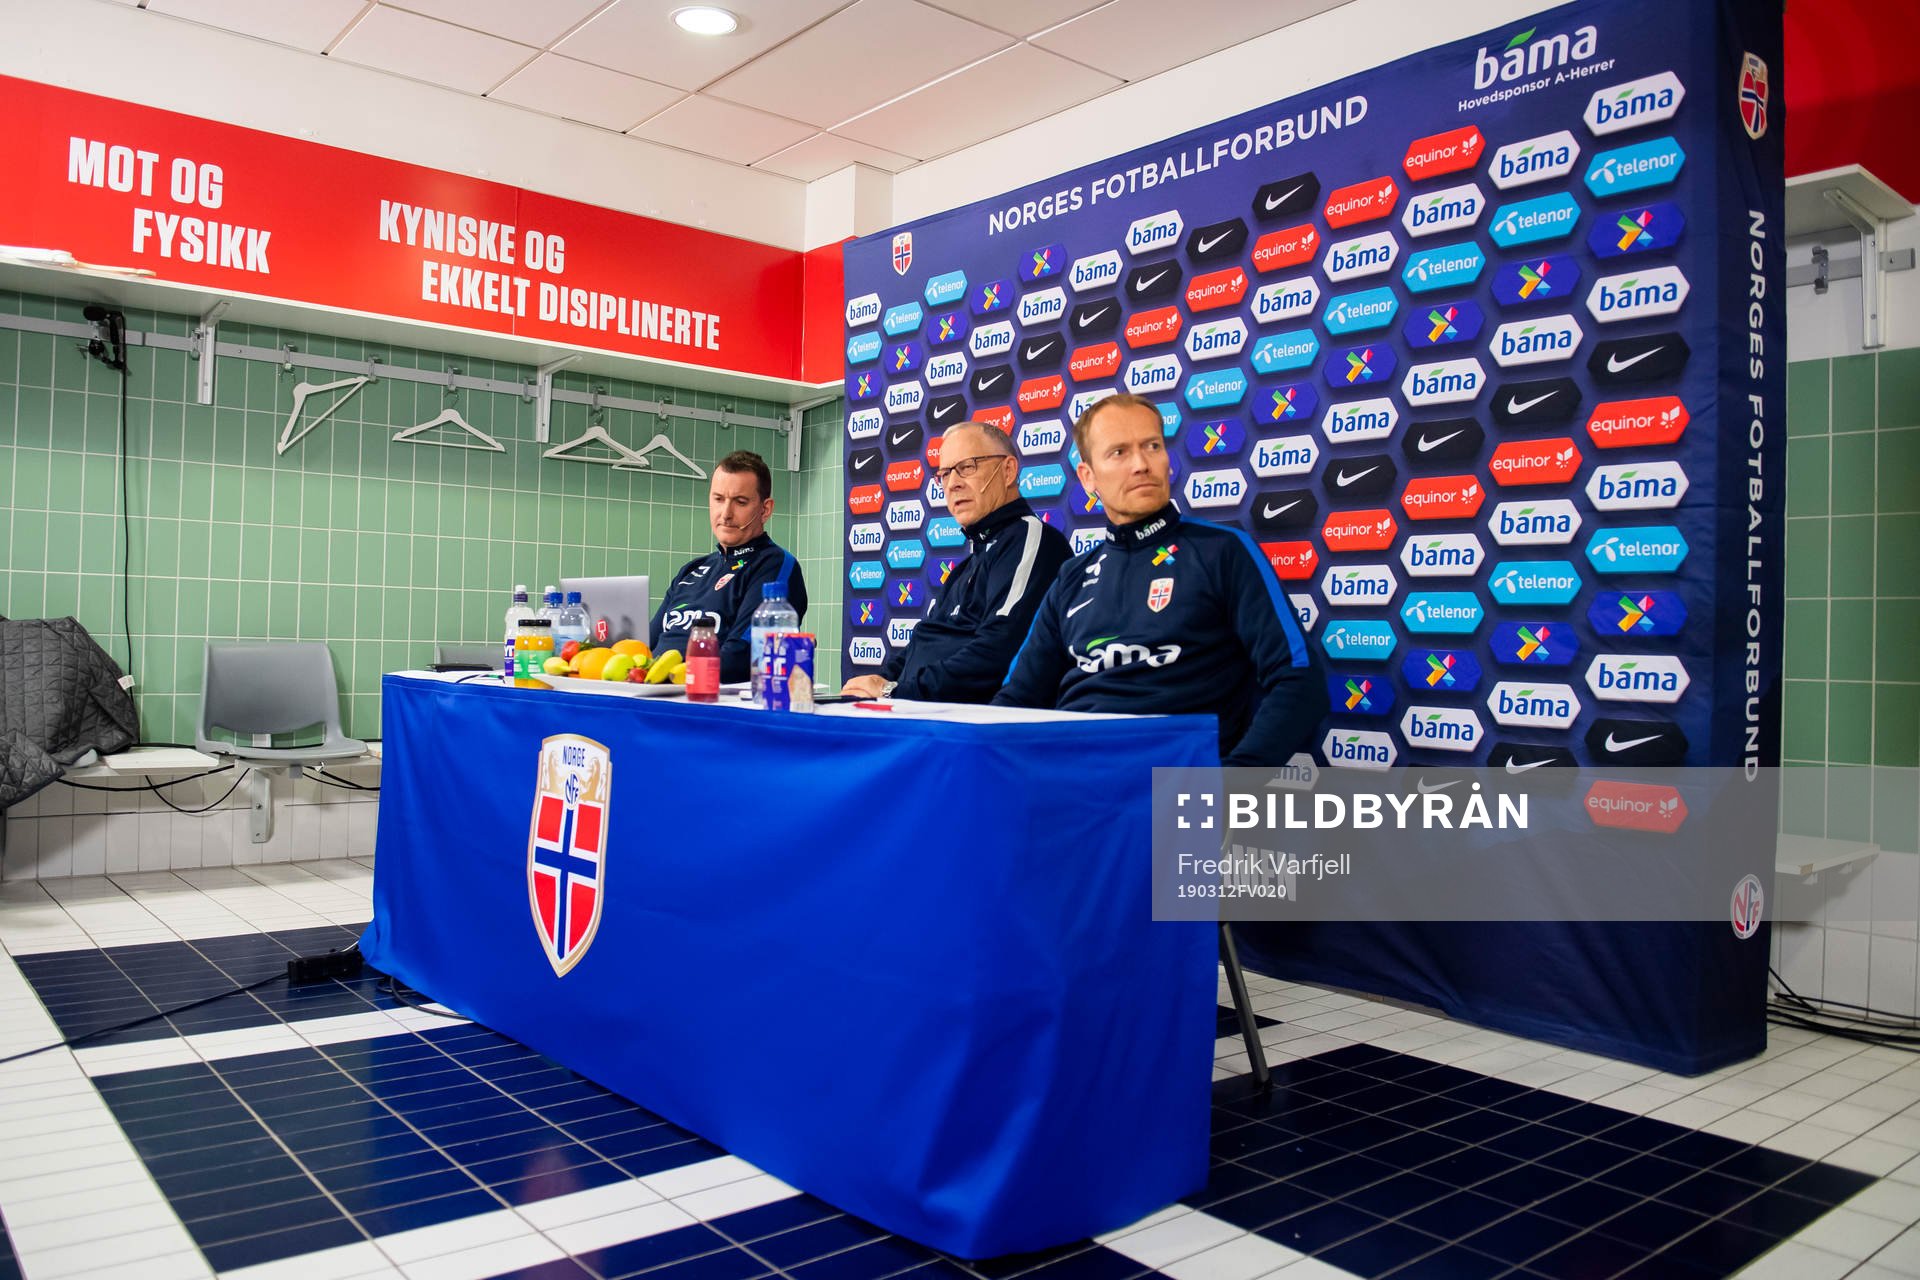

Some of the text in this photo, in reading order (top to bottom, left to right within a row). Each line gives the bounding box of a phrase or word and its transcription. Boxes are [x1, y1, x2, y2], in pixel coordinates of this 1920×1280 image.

[1473, 25, 1597, 90] bama
[1457, 57, 1616, 112] Hovedsponsor A-Herrer
[1596, 87, 1674, 125] bama
[988, 95, 1368, 235] NORGES FOTBALLFORBUND
[1406, 146, 1458, 168] equinor
[1499, 145, 1570, 179] bama
[1617, 151, 1678, 175] telenor
[68, 136, 223, 209] MOT OG
[1326, 193, 1375, 217] equinor
[1412, 197, 1476, 227] bama
[1517, 205, 1574, 228] telenor
[132, 207, 272, 274] FYSIKK
[379, 199, 565, 274] KYNISKE OG
[1132, 222, 1177, 246] bama
[1254, 241, 1298, 260] equinor
[1332, 243, 1390, 273] bama
[1076, 262, 1117, 284] bama
[1428, 256, 1479, 276] telenor
[938, 281, 964, 294] telenor
[1187, 282, 1228, 301] equinor
[1600, 282, 1678, 312] bama
[422, 260, 720, 351] EKKELT DISIPLINERTE
[850, 303, 878, 320] bama
[1023, 297, 1061, 318] bama
[1259, 289, 1313, 315] bama
[1346, 299, 1393, 318] telenor
[896, 311, 921, 324] telenor
[975, 329, 1010, 351] bama
[1127, 321, 1163, 338] equinor
[858, 340, 880, 353] telenor
[1192, 330, 1241, 352] bama
[1272, 341, 1315, 358] telenor
[1500, 330, 1572, 356] bama
[930, 359, 964, 379] bama
[1071, 354, 1105, 371] equinor
[1131, 364, 1176, 387] bama
[1204, 378, 1243, 393] telenor
[1412, 373, 1476, 397] bama
[889, 390, 920, 407] bama
[1019, 387, 1050, 402] equinor
[852, 416, 880, 433] bama
[1331, 410, 1390, 434] bama
[1590, 413, 1656, 434] equinor
[1023, 430, 1061, 448] bama
[1259, 446, 1311, 468] bama
[1493, 453, 1551, 473] equinor
[887, 472, 912, 482] equinor
[1032, 475, 1062, 487] telenor
[1599, 475, 1677, 500] bama
[849, 494, 873, 506] equinor
[931, 484, 944, 499] ba
[1192, 480, 1240, 500] bama
[1404, 489, 1457, 507] equinor
[1744, 210, 1766, 783] NORGES FOTBALLFORBUND
[890, 507, 921, 523] bama
[1499, 512, 1571, 535] bama
[853, 530, 881, 546] bama
[940, 527, 962, 538] teleno
[1135, 518, 1167, 541] bama
[1325, 522, 1372, 540] equinor
[897, 549, 922, 561] telenor
[1075, 536, 1104, 553] bam
[1411, 543, 1475, 566] bama
[1618, 541, 1680, 557] telenor
[860, 569, 883, 580] telenor
[1518, 574, 1574, 590] telenor
[1331, 575, 1389, 596] bama
[1427, 605, 1477, 620] telenor
[891, 624, 914, 639] bam
[1345, 632, 1391, 646] telenor
[853, 643, 882, 659] bama
[1599, 663, 1677, 691] bama
[1499, 690, 1570, 718] bama
[1411, 714, 1474, 742] bama
[563, 745, 585, 768] NORGE
[1331, 735, 1389, 763] bama
[1588, 795, 1654, 815] equinor
